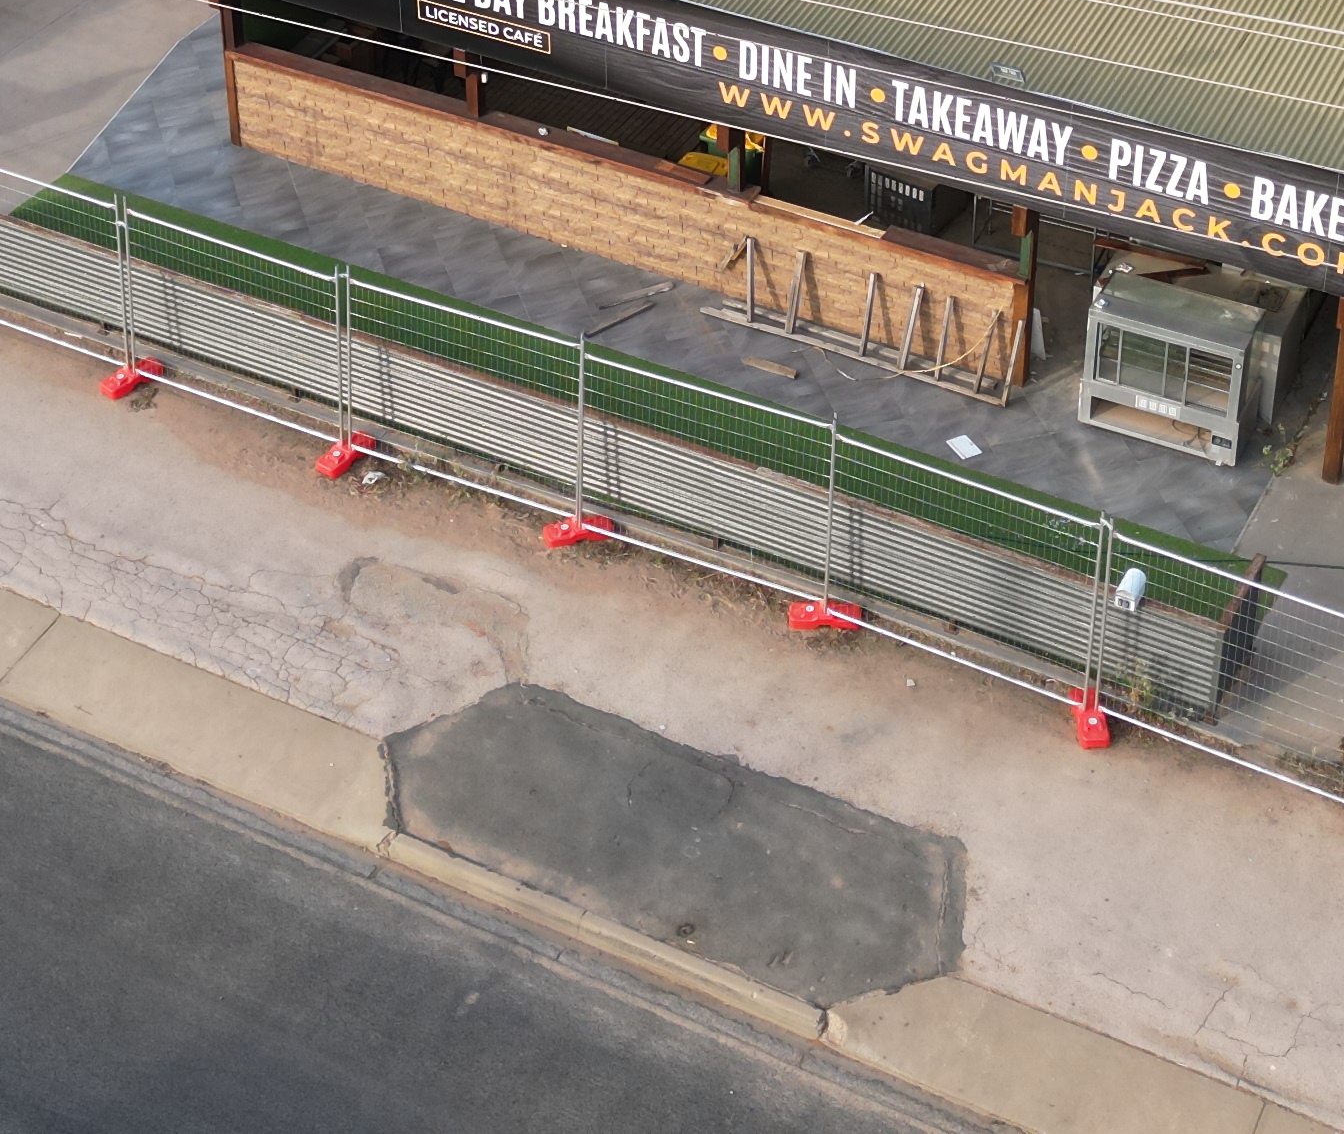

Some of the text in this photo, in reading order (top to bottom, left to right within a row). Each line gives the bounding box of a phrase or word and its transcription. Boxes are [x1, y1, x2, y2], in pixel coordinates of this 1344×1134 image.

[425, 5, 544, 49] LICENSED CAFÉ
[738, 39, 813, 97] DINE
[823, 61, 857, 109] IN
[891, 79, 1073, 166] TAKEAWAY
[1108, 138, 1210, 205] PIZZA
